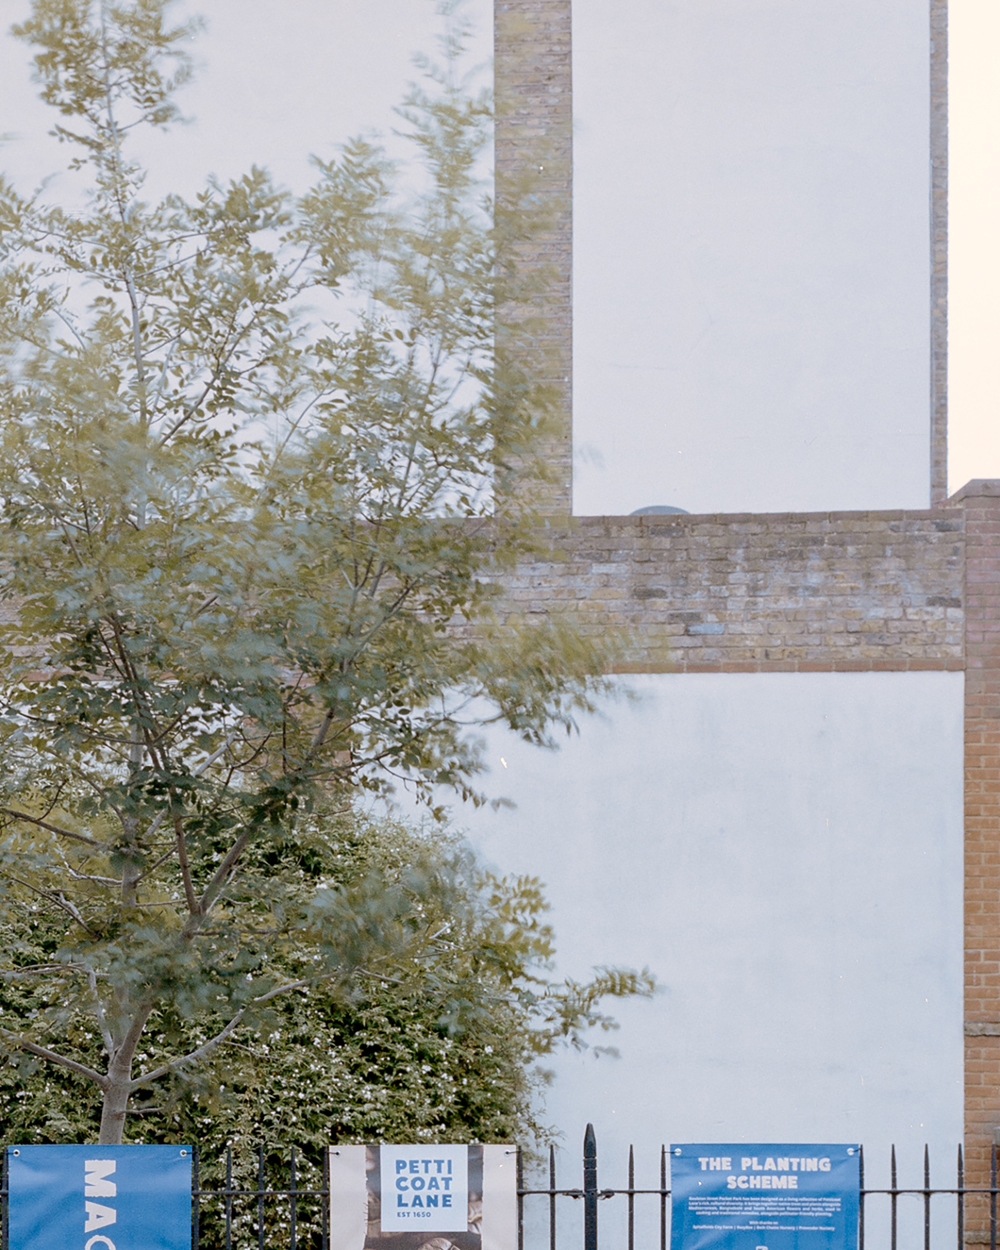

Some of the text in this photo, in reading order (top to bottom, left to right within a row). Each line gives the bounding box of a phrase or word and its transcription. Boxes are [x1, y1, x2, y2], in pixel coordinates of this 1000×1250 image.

[395, 1159, 452, 1174] PETTI
[698, 1157, 832, 1172] THE PLANTING
[395, 1176, 453, 1191] COAT
[727, 1175, 798, 1189] SCHEME
[397, 1194, 452, 1208] LANE
